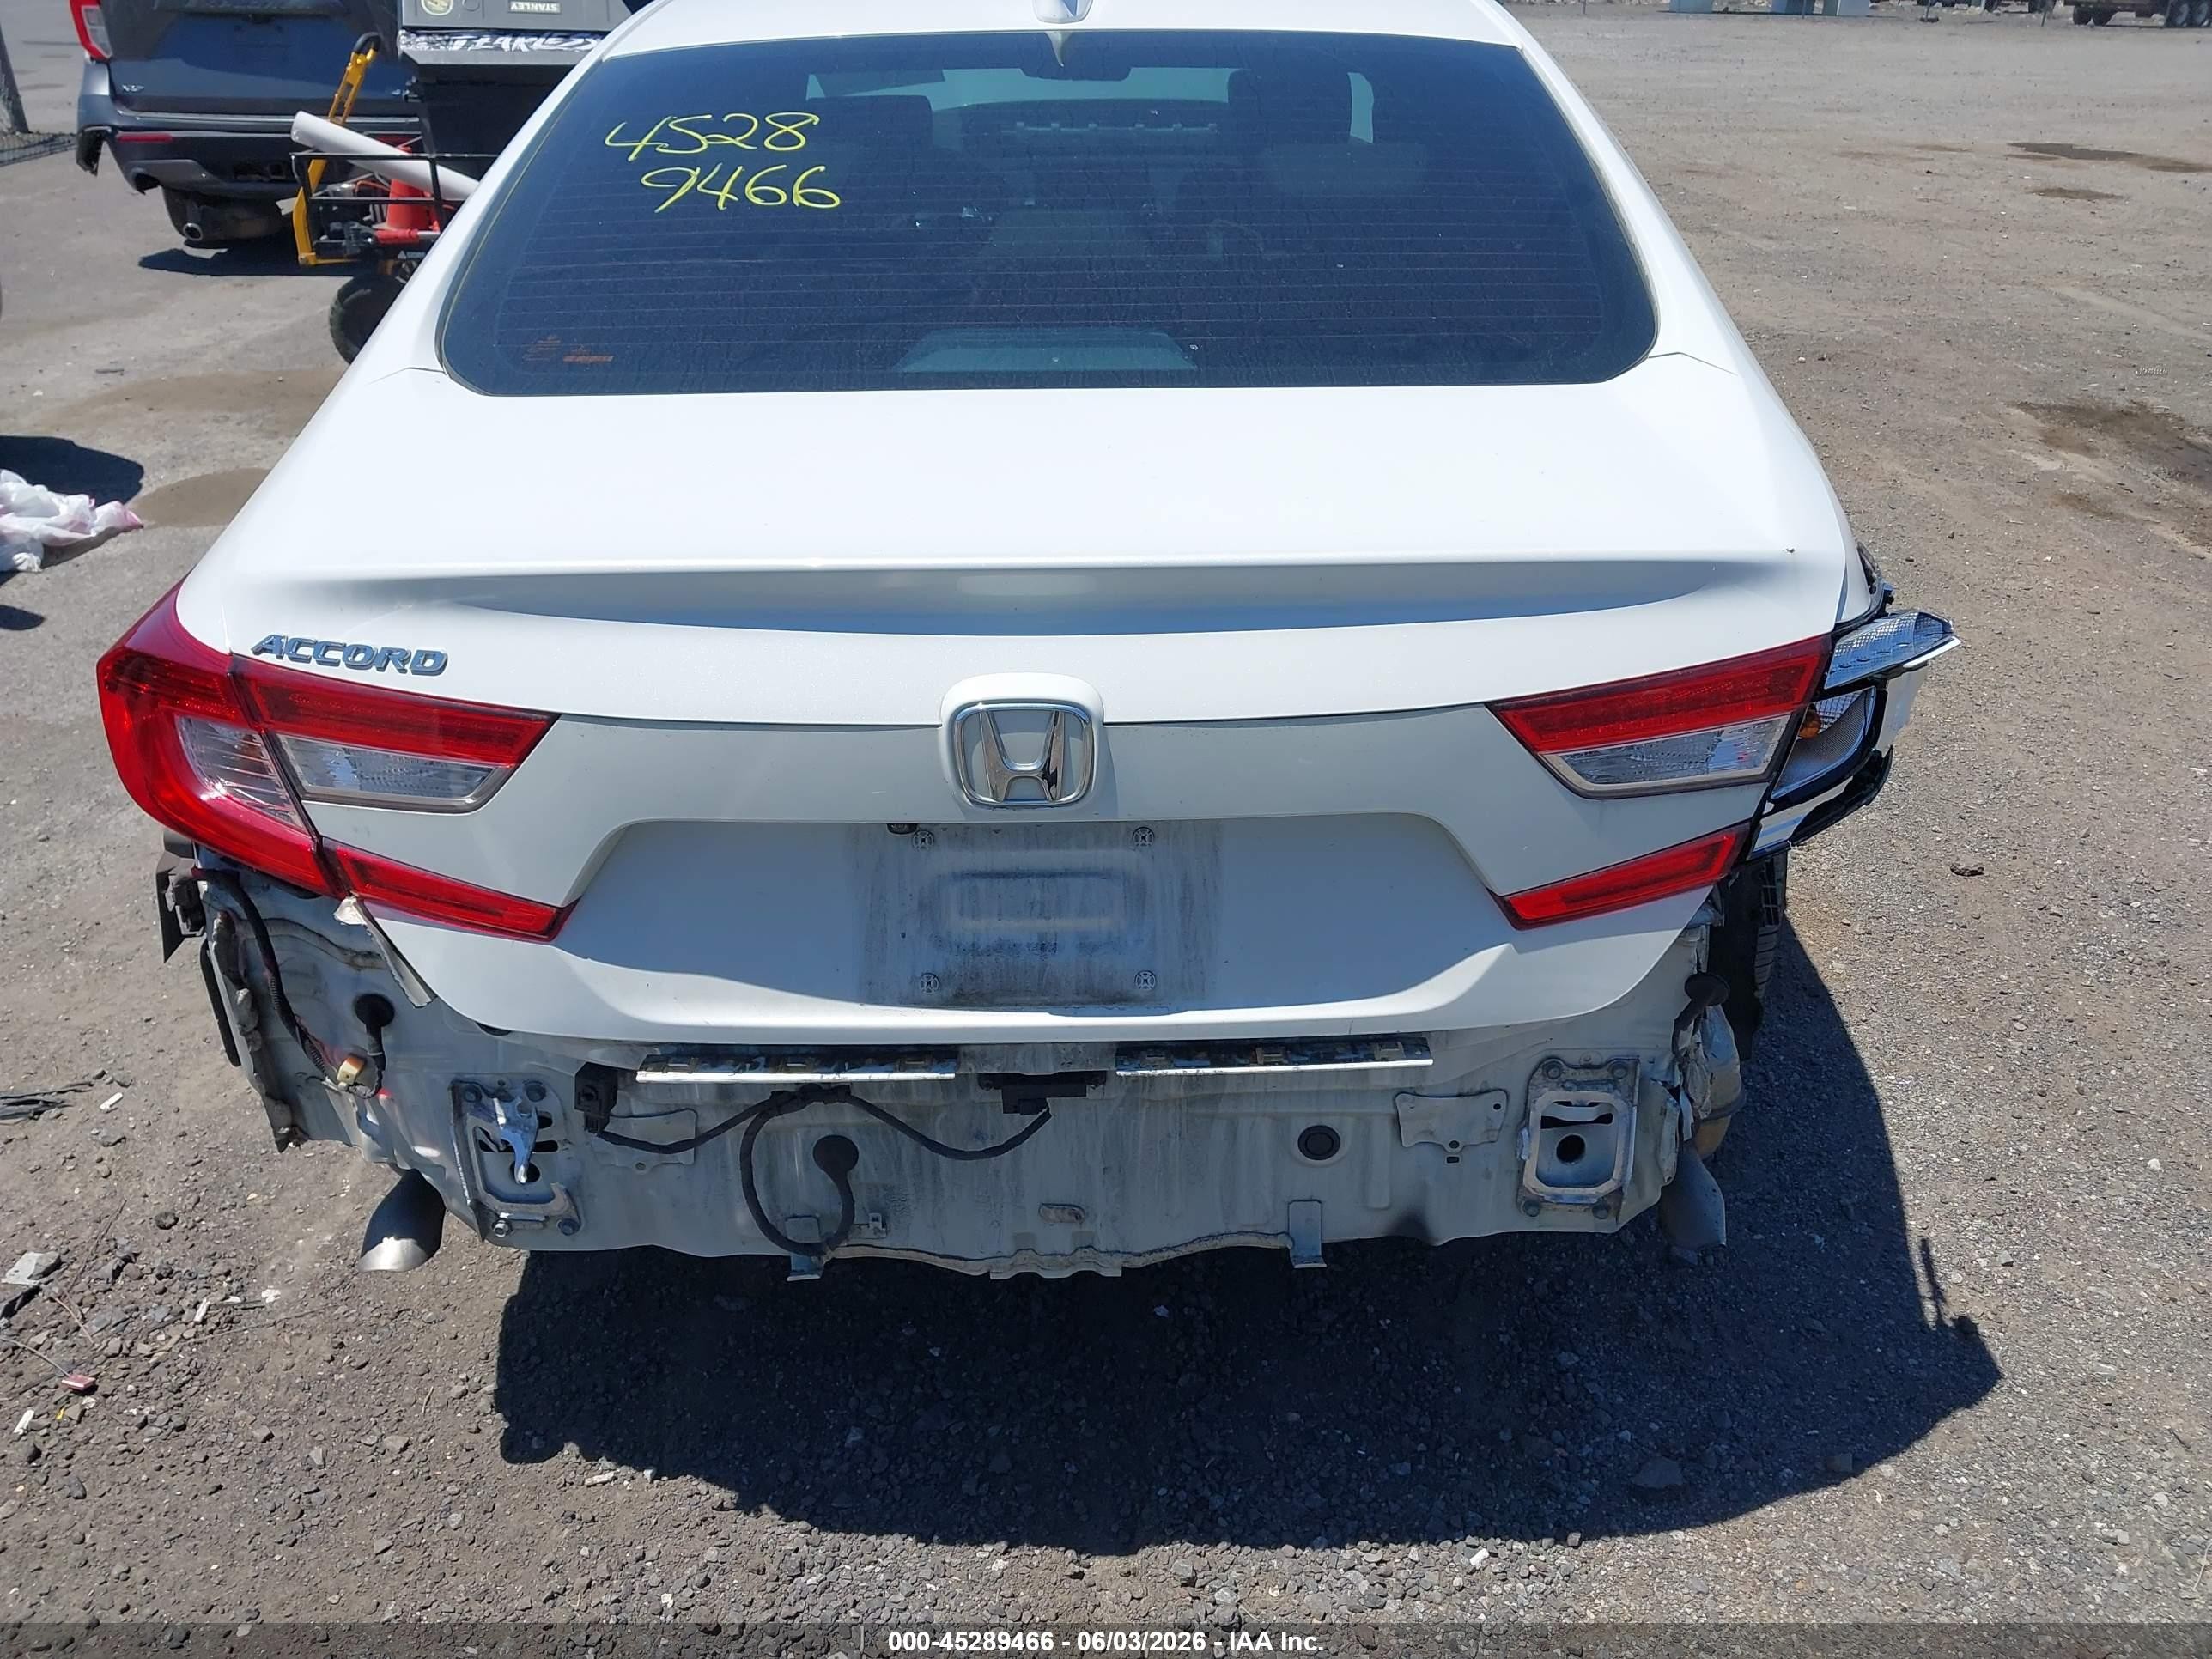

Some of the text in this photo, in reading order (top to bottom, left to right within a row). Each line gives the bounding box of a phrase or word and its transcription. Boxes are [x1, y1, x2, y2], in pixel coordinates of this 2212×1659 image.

[604, 111, 820, 161] 4528
[641, 162, 841, 213] 9466
[250, 634, 448, 677] ACCORD
